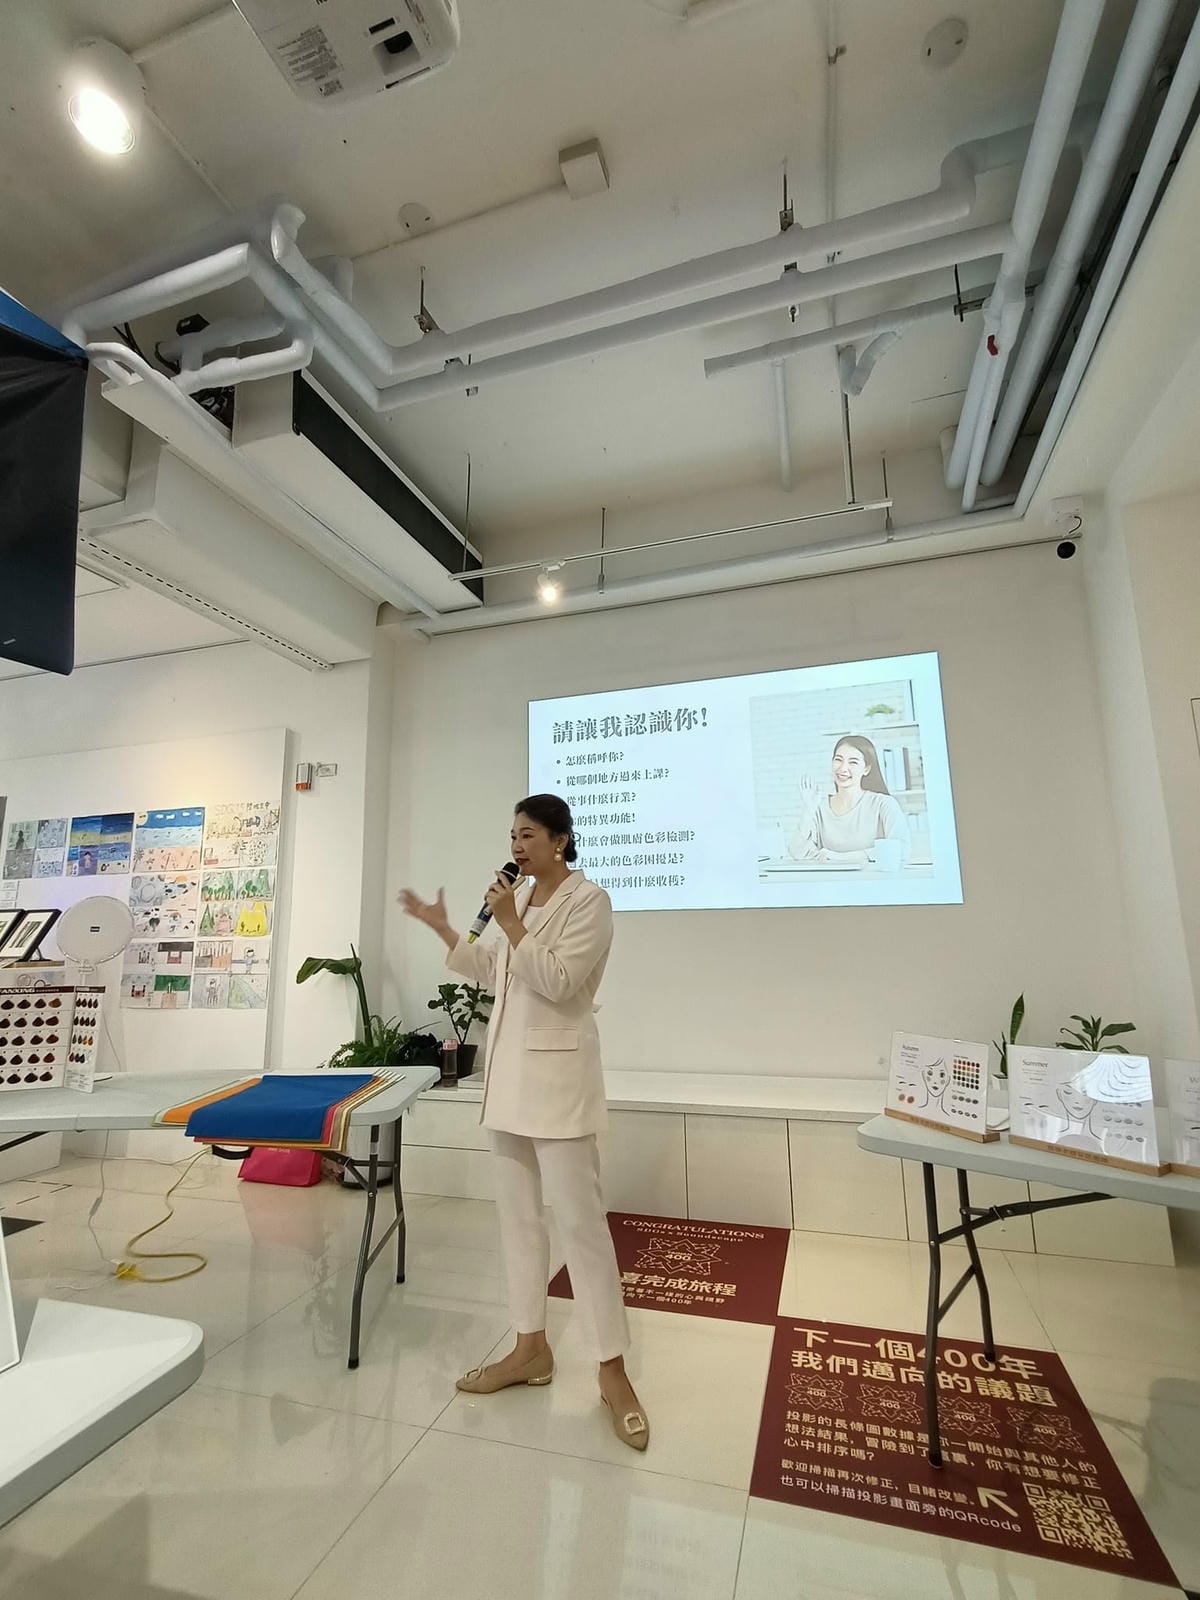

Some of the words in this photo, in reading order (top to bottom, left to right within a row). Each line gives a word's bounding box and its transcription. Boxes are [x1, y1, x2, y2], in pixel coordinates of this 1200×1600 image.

[552, 707, 708, 744] 請讓我認識你!
[566, 752, 624, 766] 怎麼稱呼你?
[574, 812, 635, 827] 的特異功能!
[578, 830, 695, 848] 什麼會做肌膚色彩檢測?
[595, 875, 685, 889] 想得到什麼收穫?
[1022, 1059, 1048, 1068] Summer
[623, 1220, 765, 1239] CONGRATULATIONS
[624, 1292, 692, 1305] 向下一個400年
[791, 1350, 1057, 1407] 我們邁向的議題
